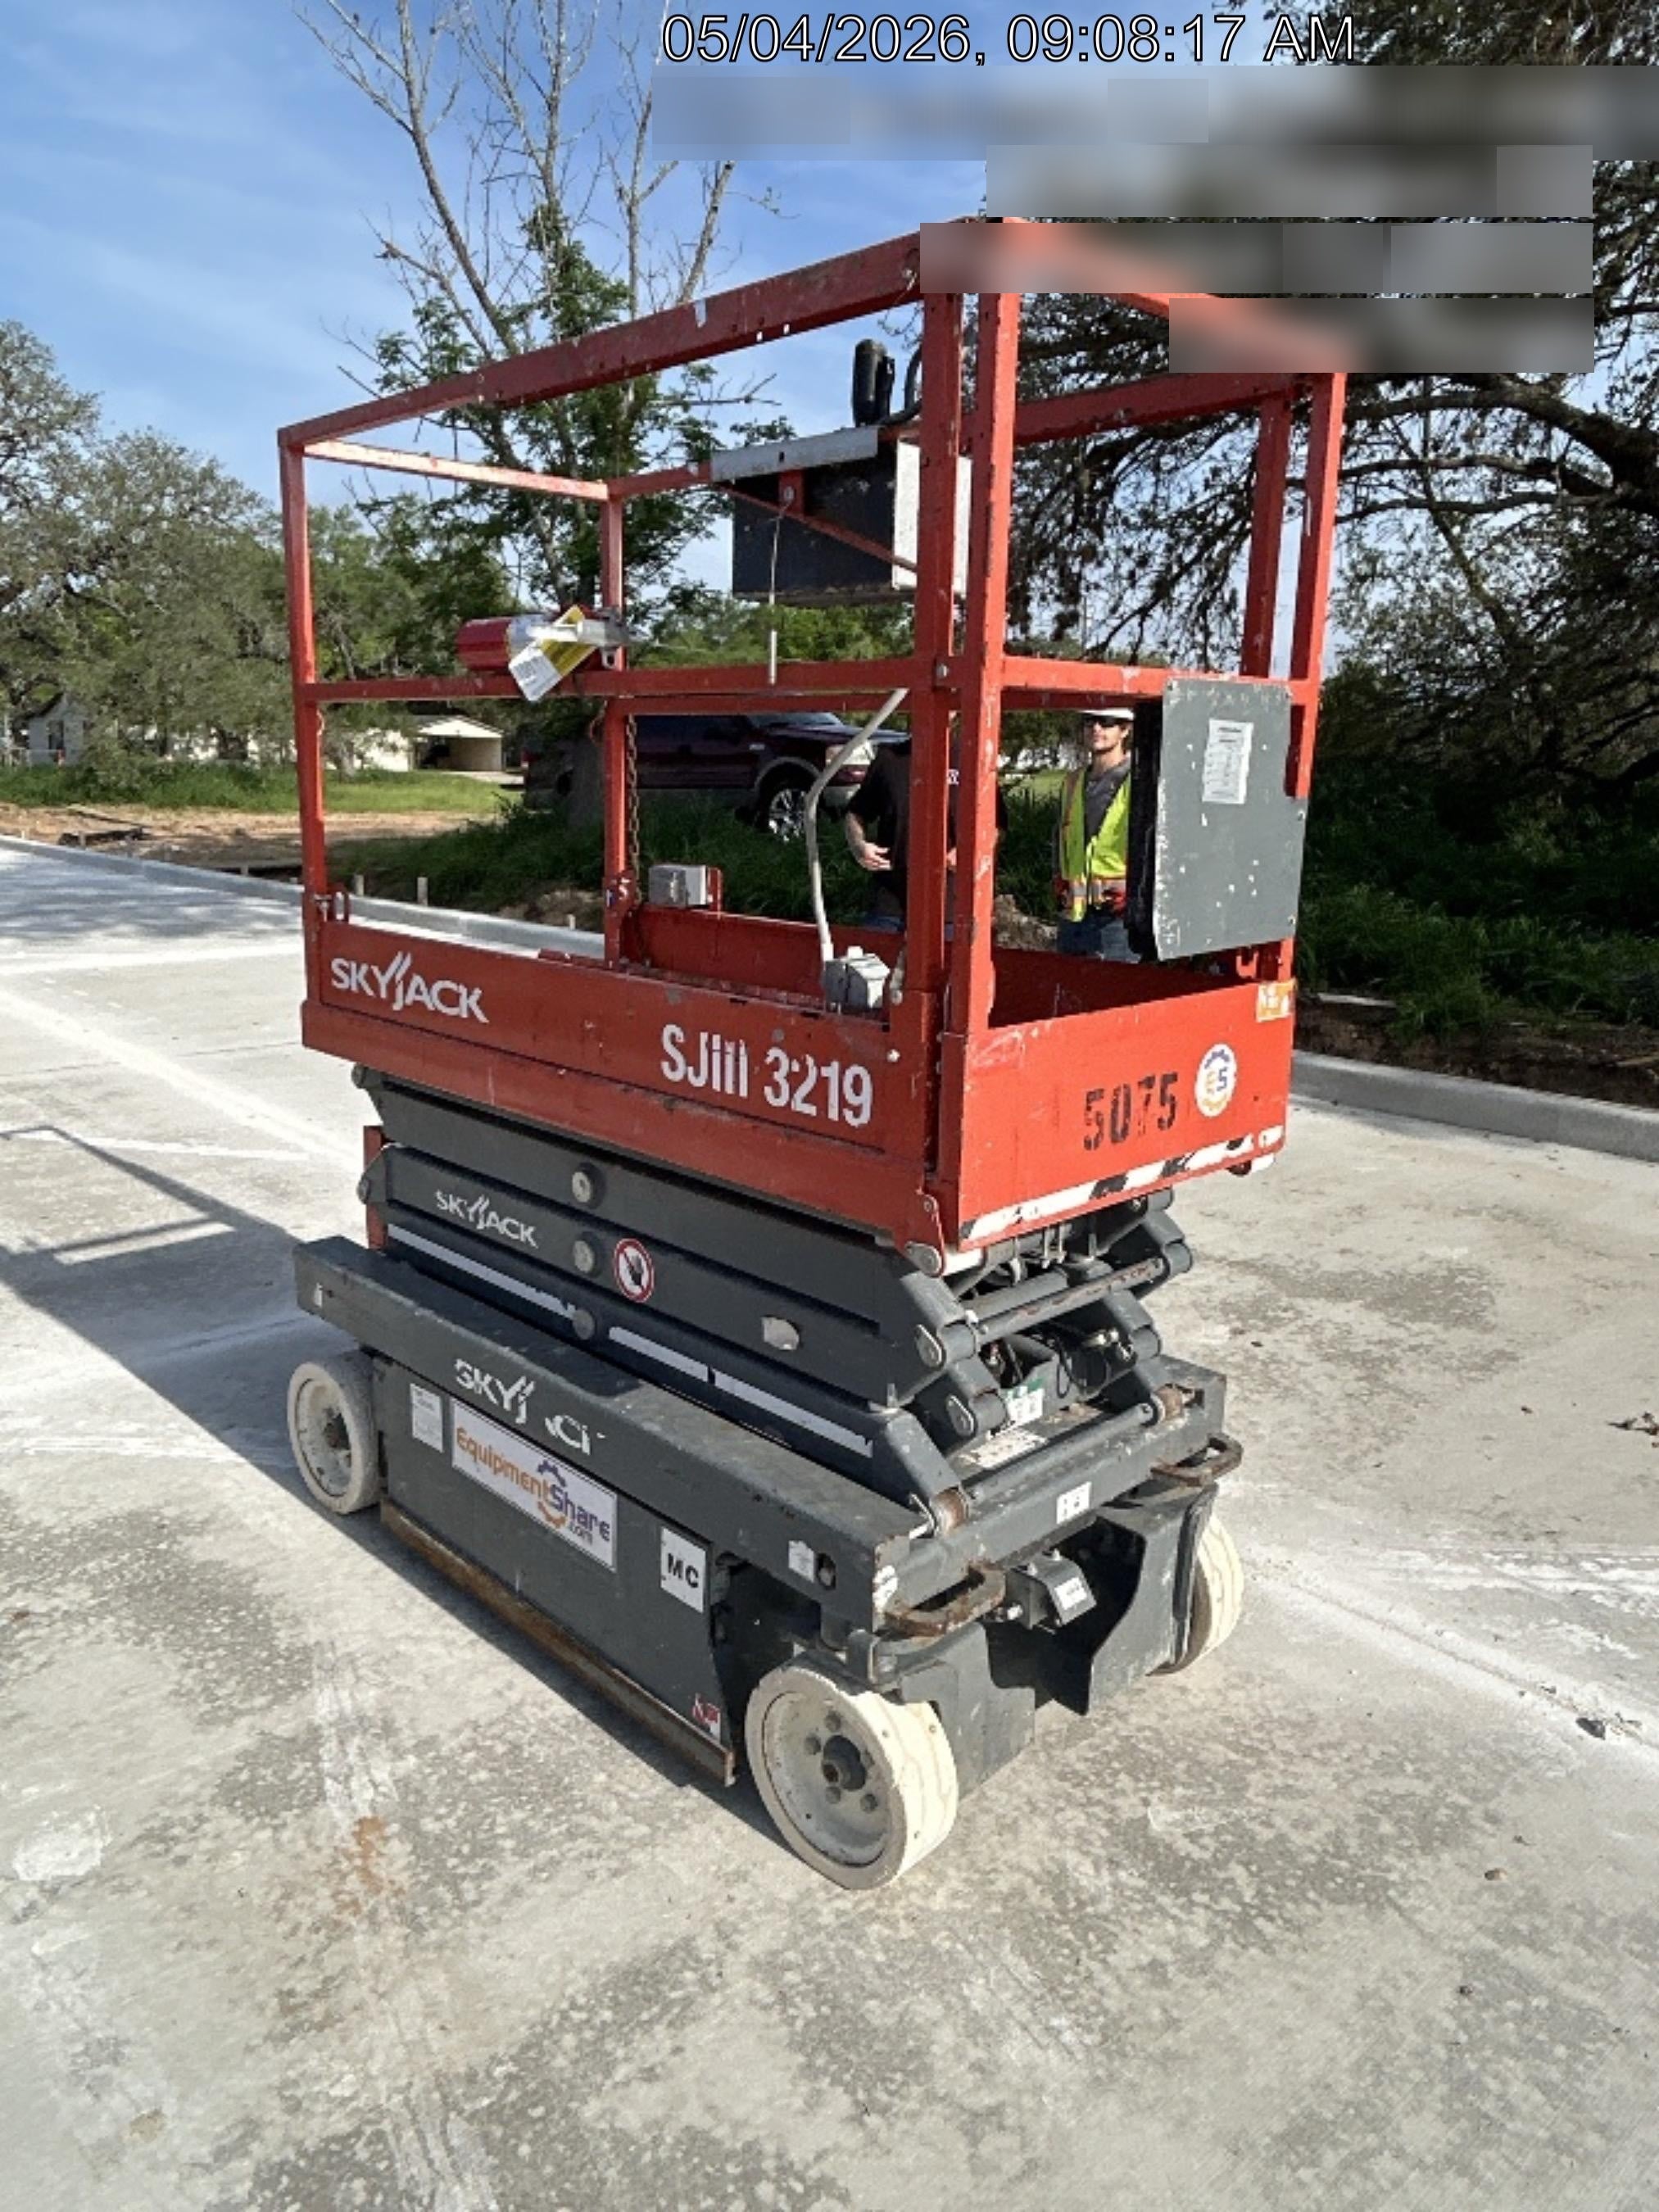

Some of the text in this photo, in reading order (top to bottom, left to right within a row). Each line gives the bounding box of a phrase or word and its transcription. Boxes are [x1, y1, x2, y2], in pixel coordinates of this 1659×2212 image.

[331, 950, 489, 1023] SKYJACK
[764, 1046, 873, 1127] 3219
[1084, 1072, 1178, 1151] 5075
[435, 1190, 539, 1249] SKYJACK
[668, 1552, 699, 1589] MC
